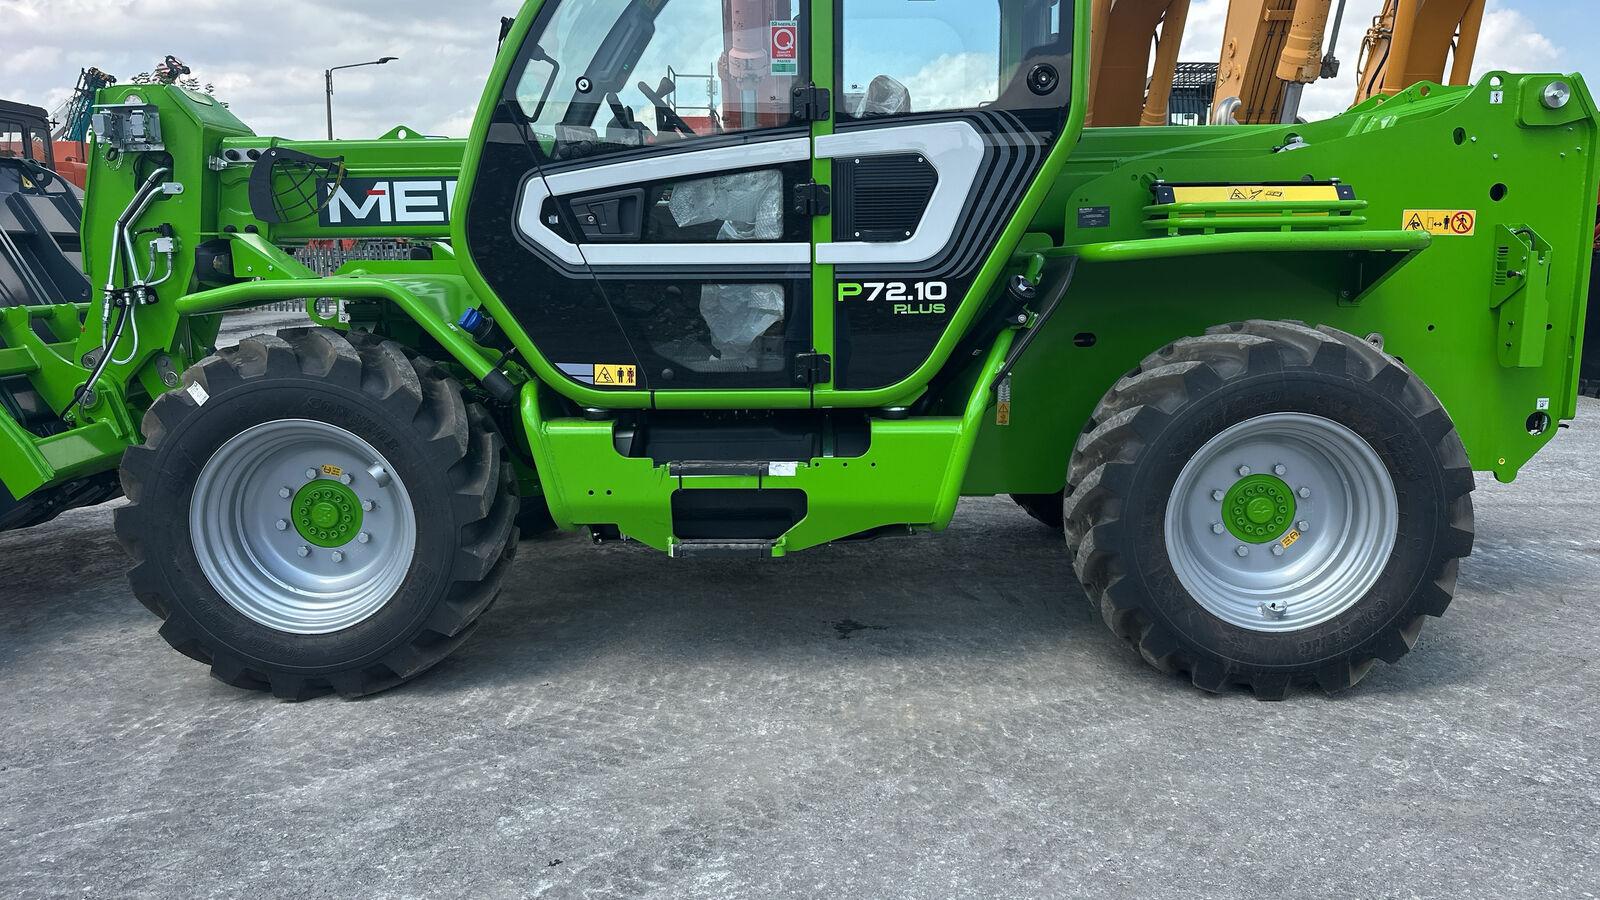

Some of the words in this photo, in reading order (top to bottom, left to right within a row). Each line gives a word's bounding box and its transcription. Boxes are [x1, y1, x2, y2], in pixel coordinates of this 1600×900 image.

[327, 180, 457, 223] ME
[837, 281, 948, 302] P72.10
[893, 303, 946, 315] PLUS
